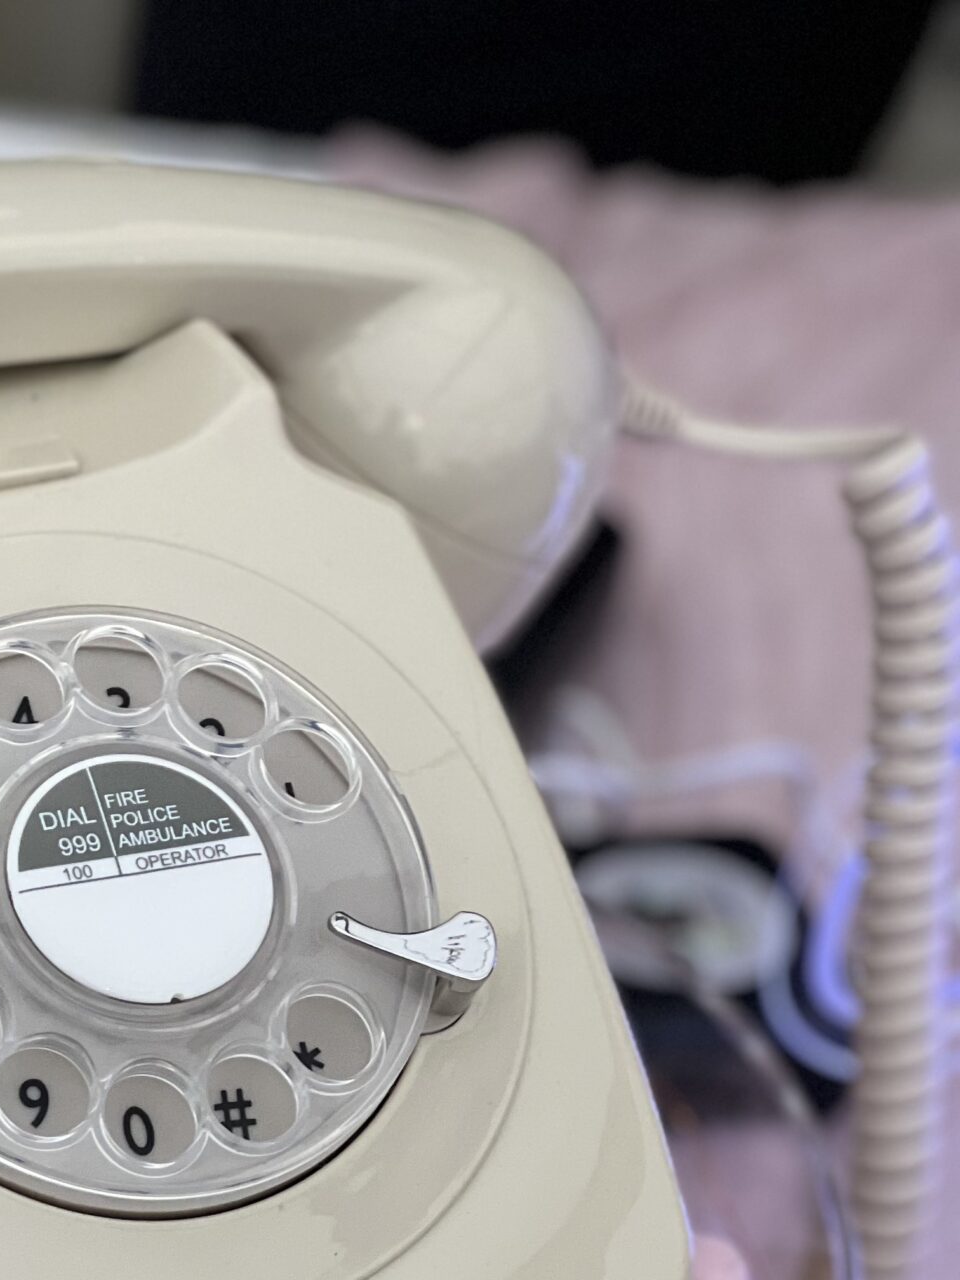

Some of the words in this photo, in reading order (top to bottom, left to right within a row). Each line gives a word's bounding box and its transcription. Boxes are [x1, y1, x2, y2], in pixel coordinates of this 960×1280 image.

[103, 788, 149, 809] FIRE
[38, 806, 97, 831] DIAL
[109, 804, 181, 828] POLICE
[58, 833, 101, 856] 999
[118, 817, 233, 849] AMBULANCE
[62, 864, 94, 881] 100
[135, 843, 229, 871] OPERATOR
[18, 1078, 50, 1129] 9
[213, 1087, 257, 1141] #
[122, 1105, 156, 1157] 0
